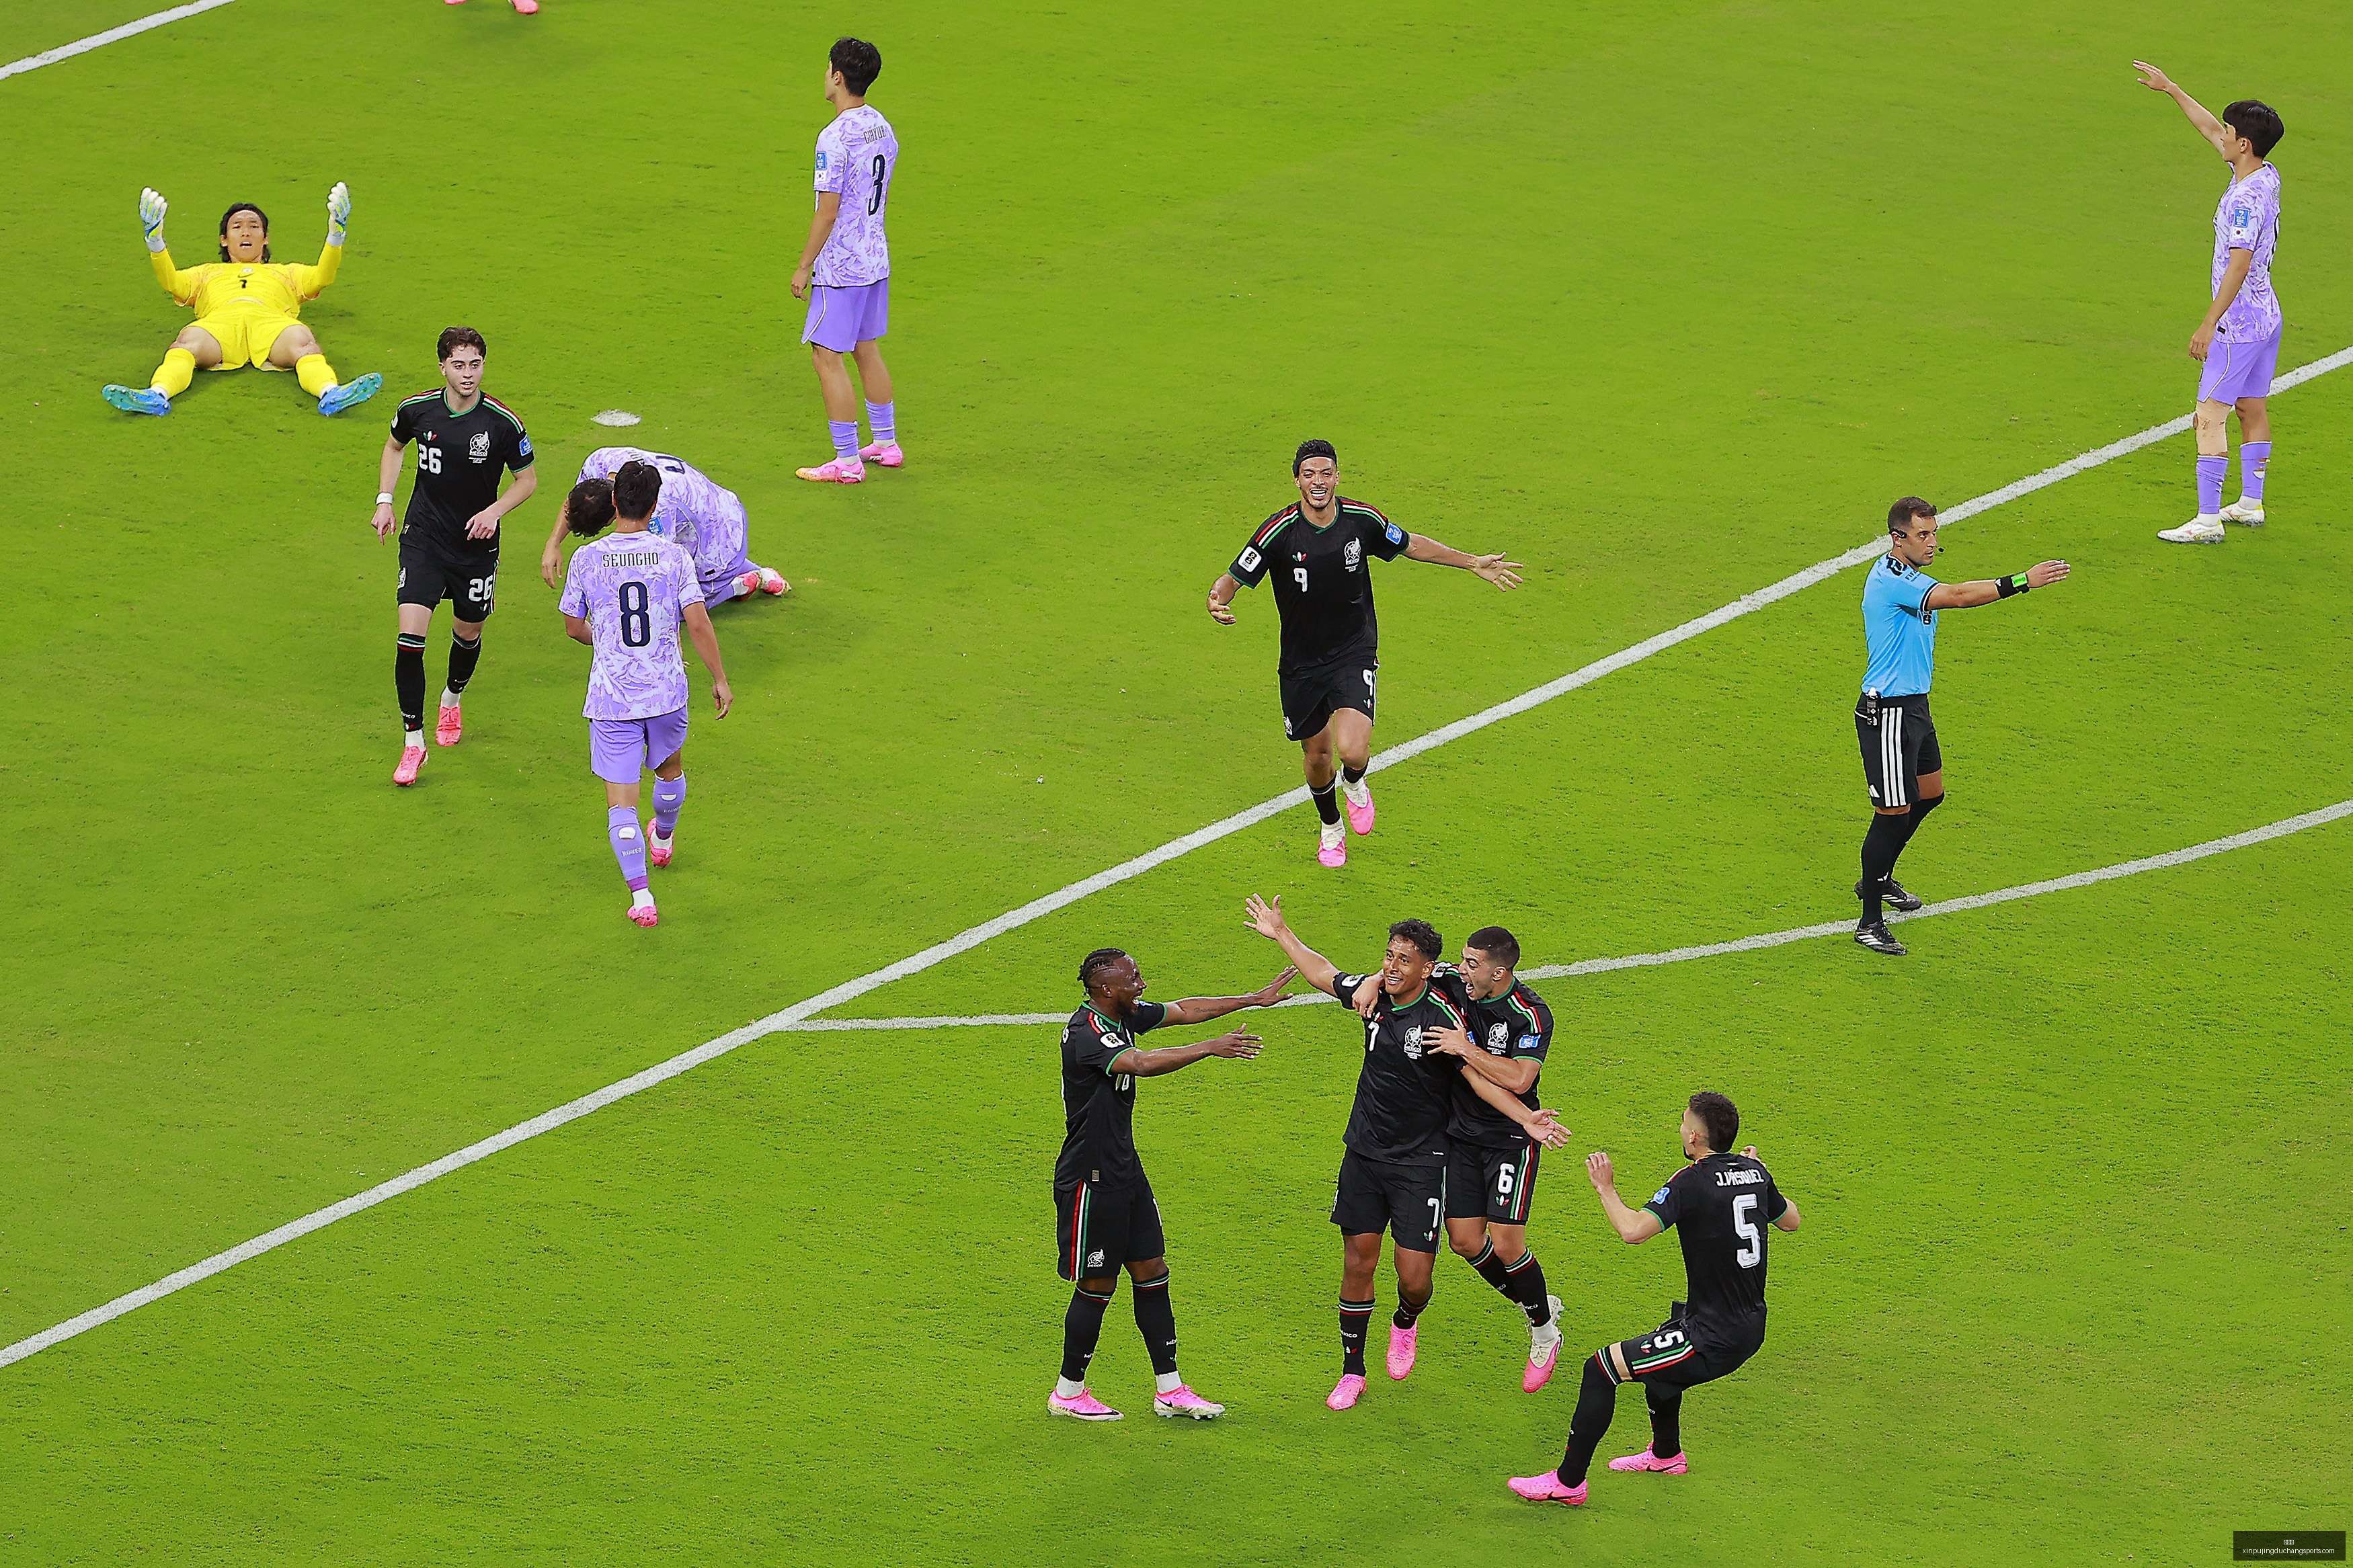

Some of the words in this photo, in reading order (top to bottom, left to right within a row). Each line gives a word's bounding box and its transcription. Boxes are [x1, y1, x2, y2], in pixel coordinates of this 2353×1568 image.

[868, 154, 885, 216] 3
[418, 444, 442, 474] 26
[602, 552, 659, 567] SEUNGHO
[469, 575, 493, 602] 26
[1293, 568, 1308, 593] 9
[619, 581, 651, 647] 8
[1363, 669, 1373, 696] 9
[1368, 1021, 1380, 1052] 7
[1497, 1163, 1515, 1194] 6
[1427, 1198, 1440, 1228] 7
[1732, 1194, 1761, 1269] 5
[1654, 1331, 1685, 1349] 5
